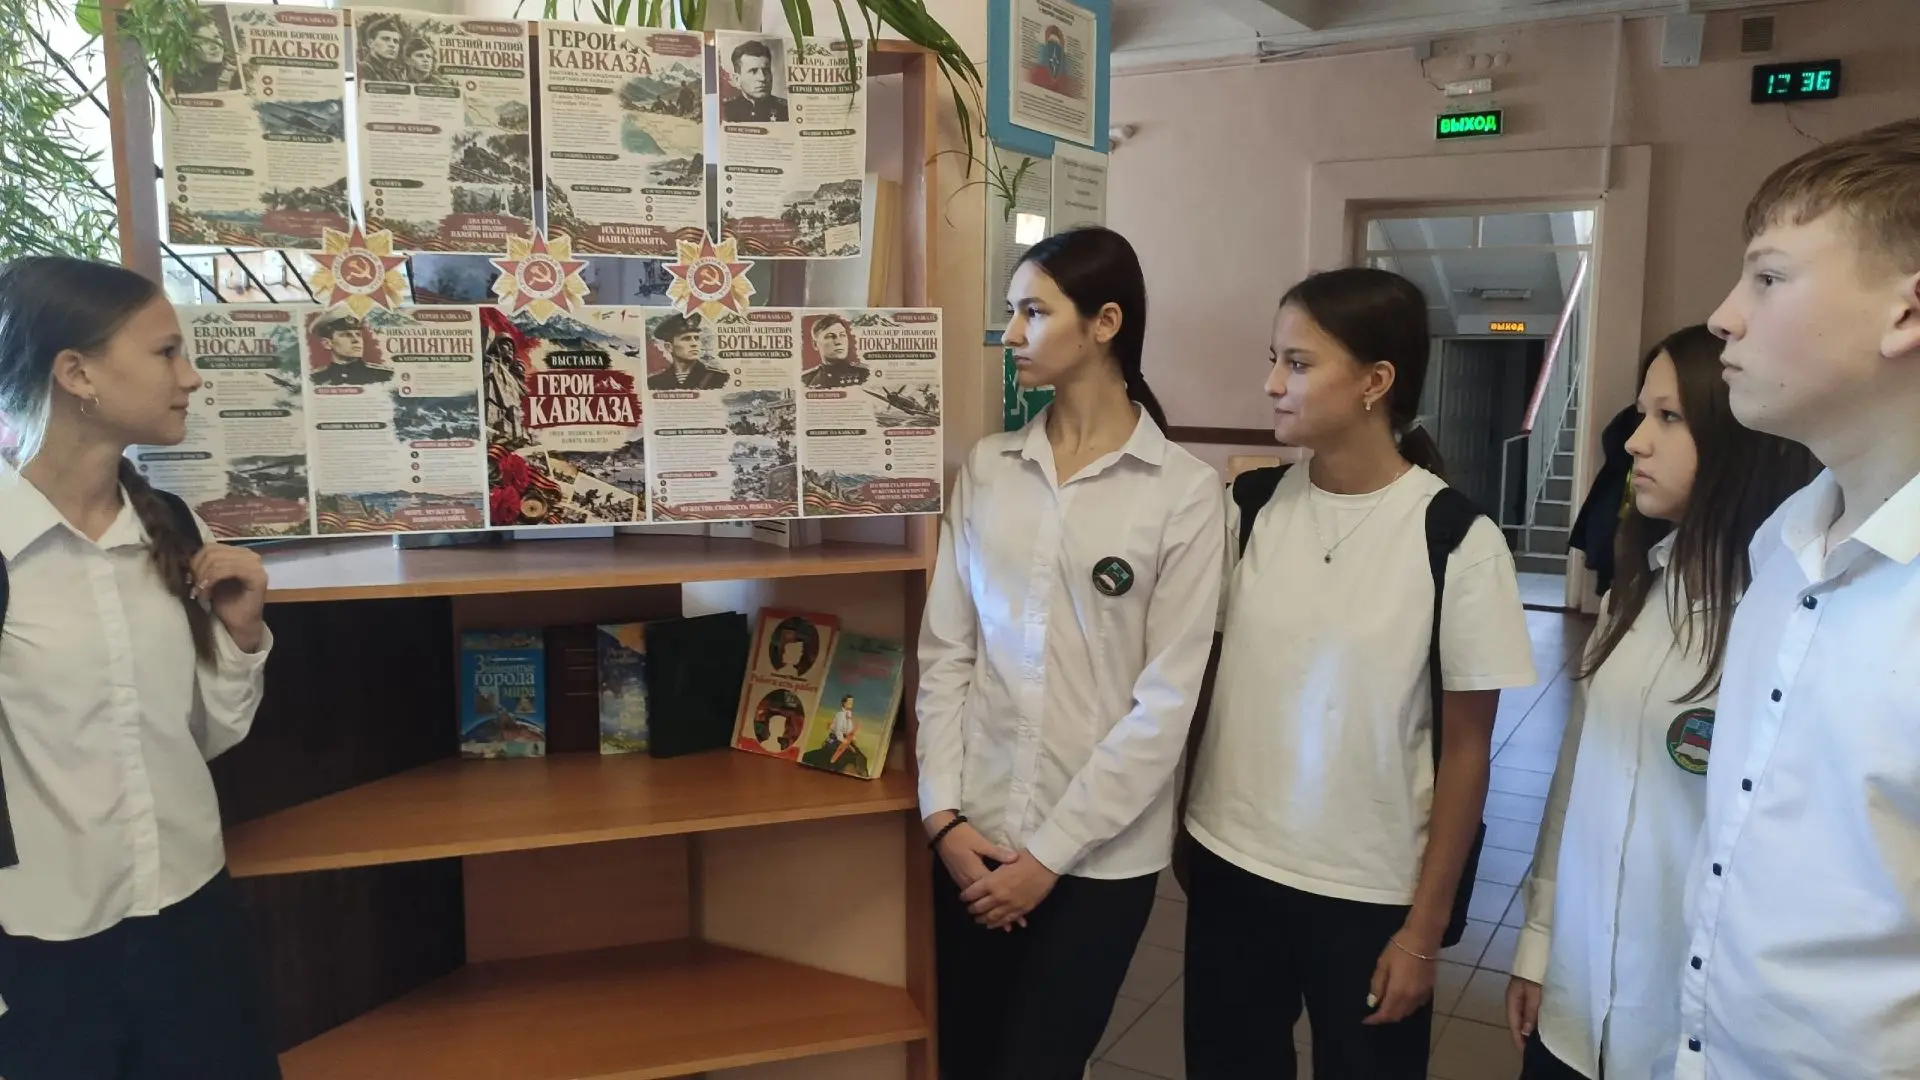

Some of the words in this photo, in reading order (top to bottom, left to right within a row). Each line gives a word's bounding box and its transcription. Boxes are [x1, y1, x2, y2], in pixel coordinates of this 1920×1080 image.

[440, 38, 483, 48] ЕВГЕНИЙ
[486, 42, 492, 50] И
[548, 28, 616, 51] ГЕРОИ
[250, 38, 340, 60] ПАСЬКО
[439, 48, 524, 68] ИГНАТОВЫ
[549, 48, 652, 74] КАВКАЗА
[1800, 70, 1832, 92] 36
[1440, 114, 1497, 134] ВЫХОД
[598, 235, 626, 244] НАША
[193, 326, 256, 338] ЕВДОКИЯ
[429, 328, 473, 336] ИВАНОВИЧ
[718, 326, 751, 334] ВАСИЛИЙ
[1490, 322, 1524, 332] ВЫХОД
[194, 338, 278, 354] НОСАЛЬ
[386, 337, 474, 354] СИПЯГИН
[718, 335, 793, 350] БОТЫЛЕВ
[859, 338, 938, 351] ПОКРЫШКИН
[552, 355, 604, 366] ВЫСТАВКА
[537, 374, 595, 396] ГЕРОИ
[528, 396, 635, 426] КАВКАЗА
[474, 672, 535, 688] города
